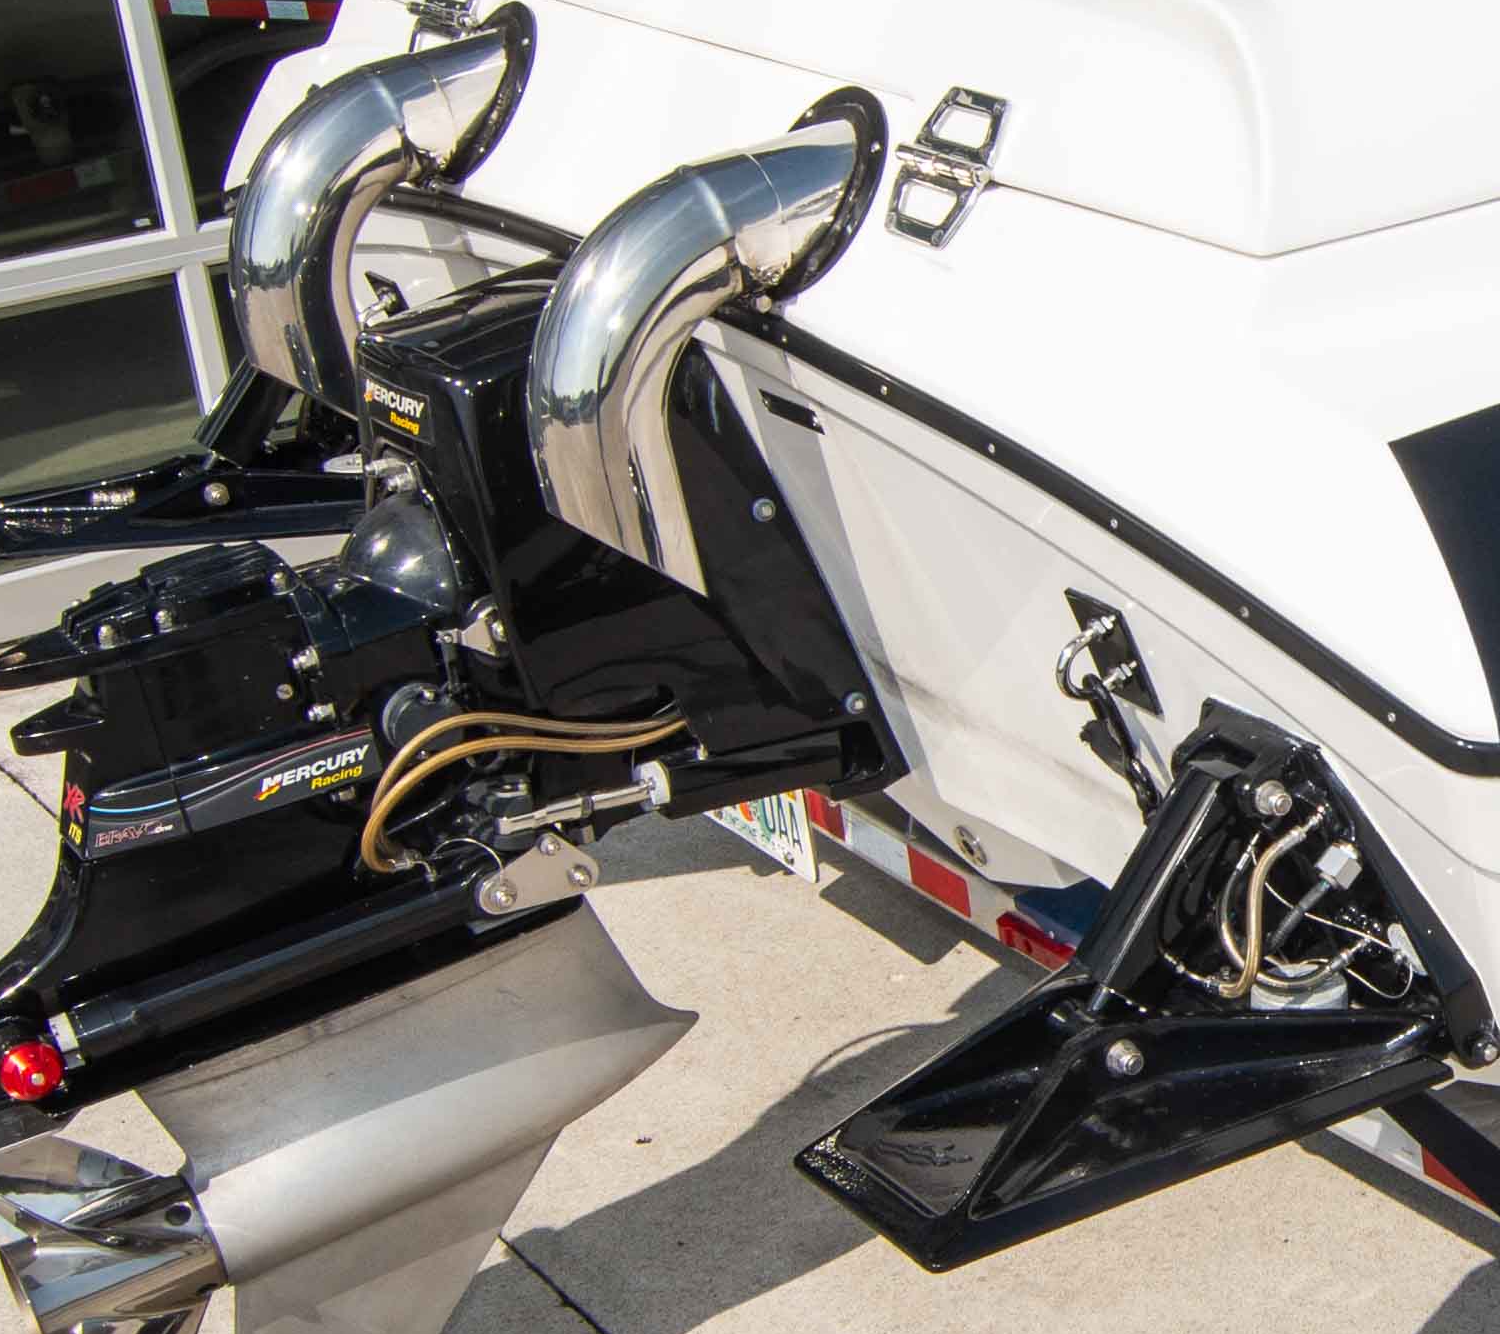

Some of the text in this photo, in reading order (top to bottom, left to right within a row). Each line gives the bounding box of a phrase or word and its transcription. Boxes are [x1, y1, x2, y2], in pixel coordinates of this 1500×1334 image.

[364, 378, 425, 419] MERCURY
[390, 411, 420, 436] Racing
[260, 744, 370, 793] MERCURY
[311, 764, 363, 790] Racing
